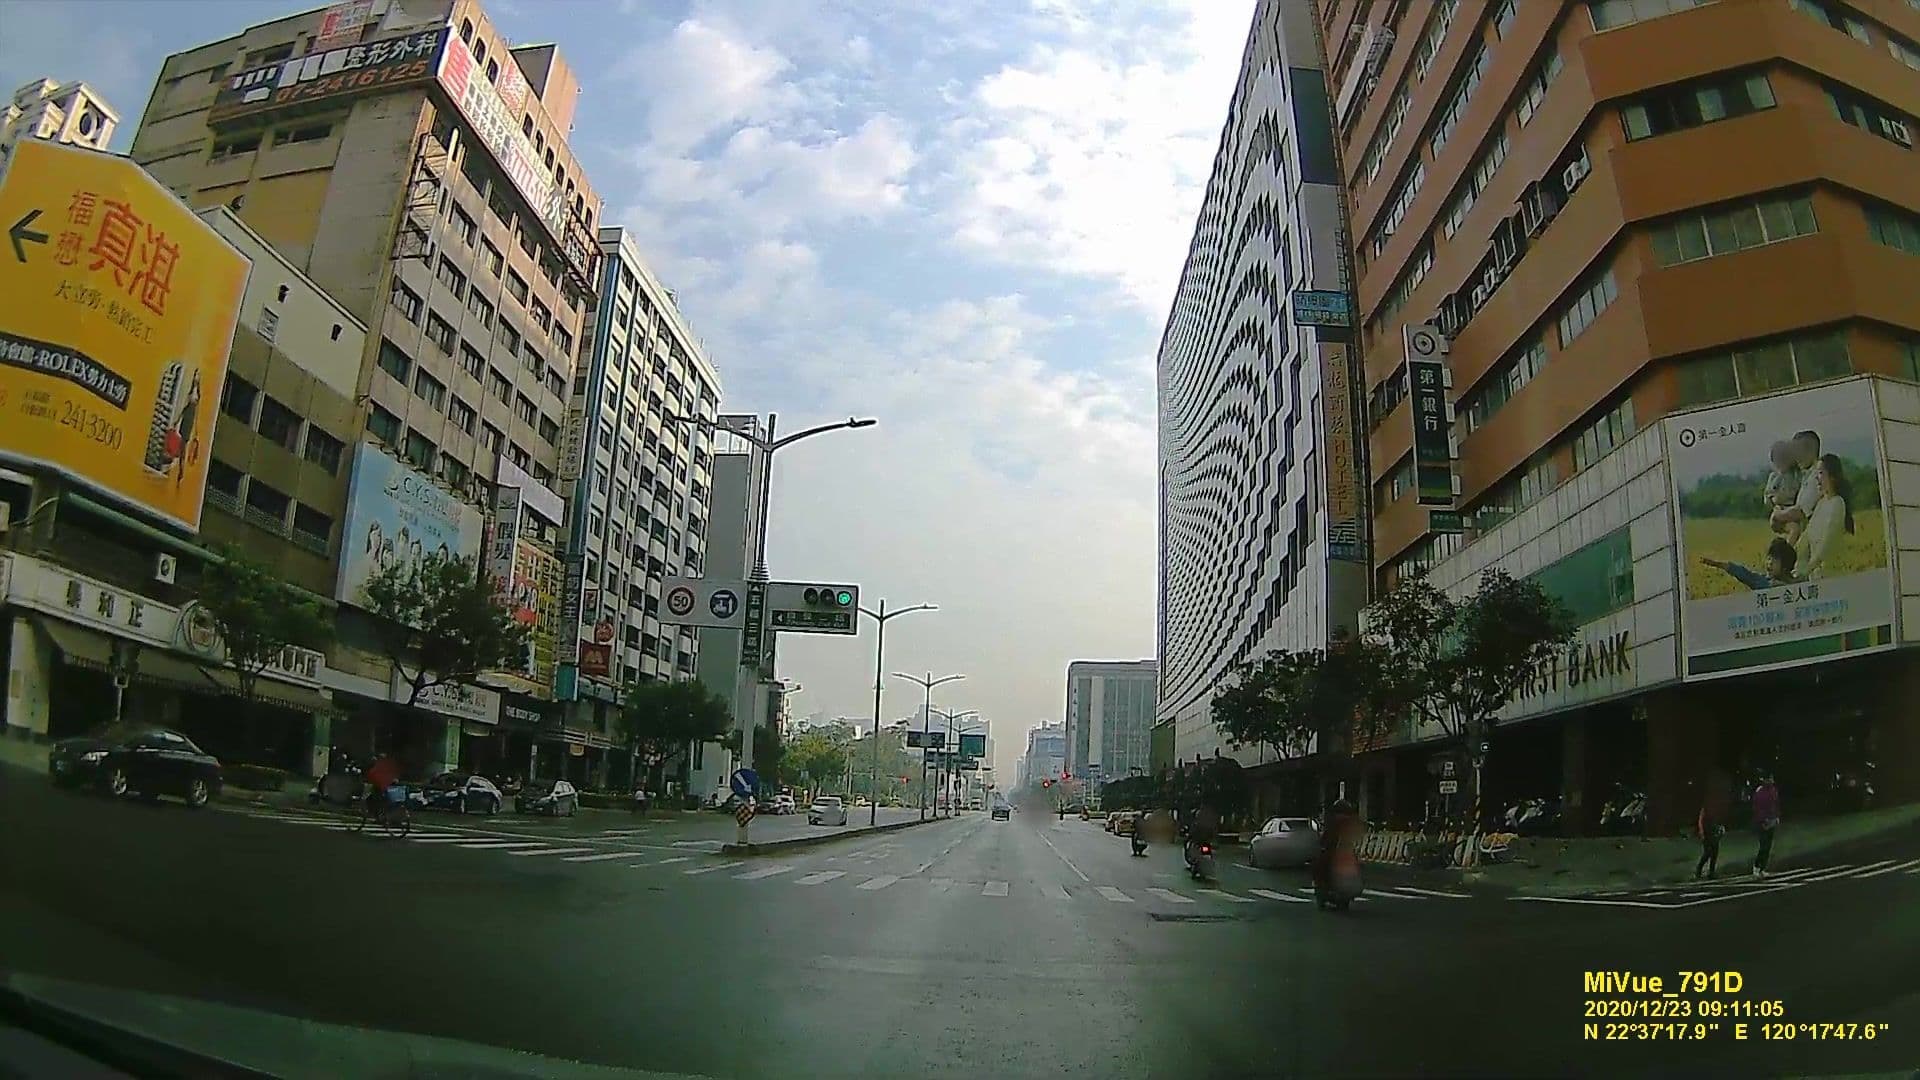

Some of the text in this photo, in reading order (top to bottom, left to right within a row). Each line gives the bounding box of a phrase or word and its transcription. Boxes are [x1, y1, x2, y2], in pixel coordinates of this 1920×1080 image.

[344, 31, 438, 70] 整形外科
[276, 60, 429, 103] 07-2416125
[1419, 369, 1438, 431] 第一銀行
[675, 595, 689, 608] 50
[1756, 584, 1820, 608] 第一金人壽
[1568, 629, 1631, 688] BANK
